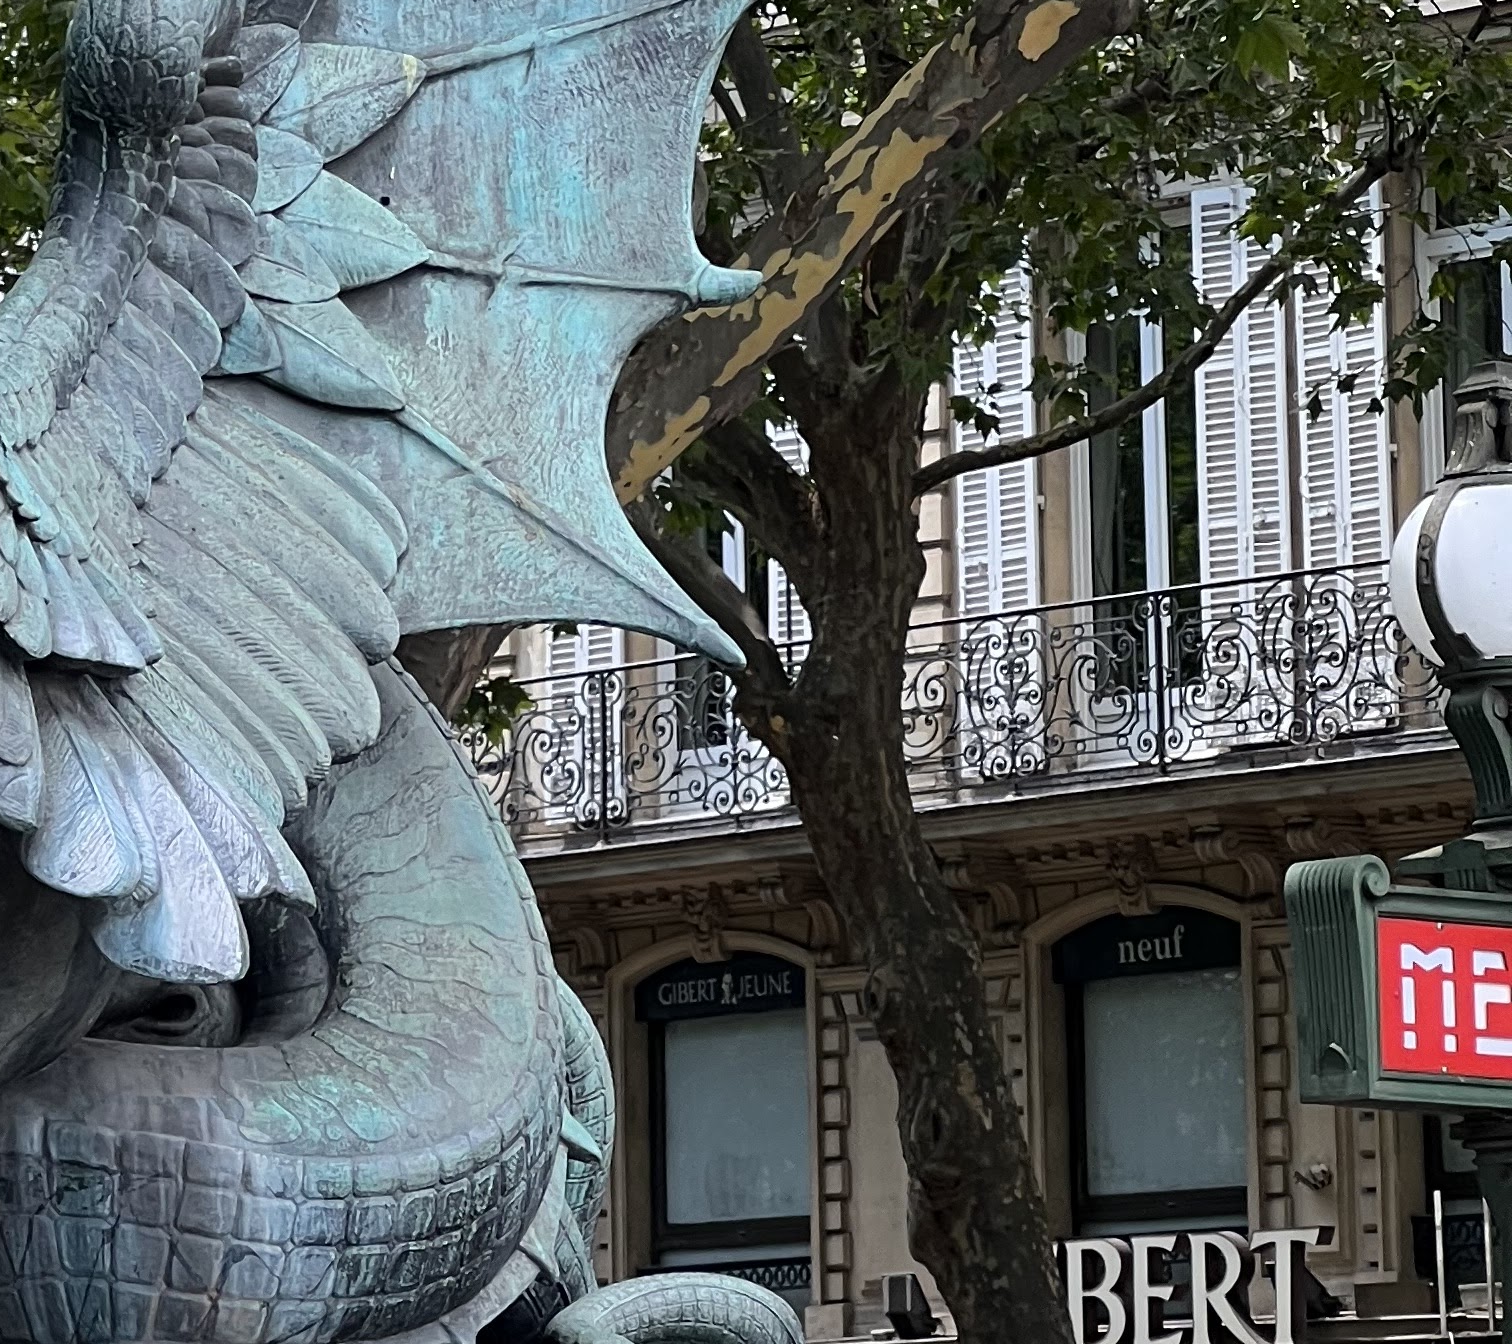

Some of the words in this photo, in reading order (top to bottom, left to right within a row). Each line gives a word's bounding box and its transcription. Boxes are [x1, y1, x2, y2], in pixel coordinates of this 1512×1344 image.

[1118, 924, 1185, 963] neuf
[658, 978, 717, 1005] GIBERT
[737, 971, 793, 999] JEUNE
